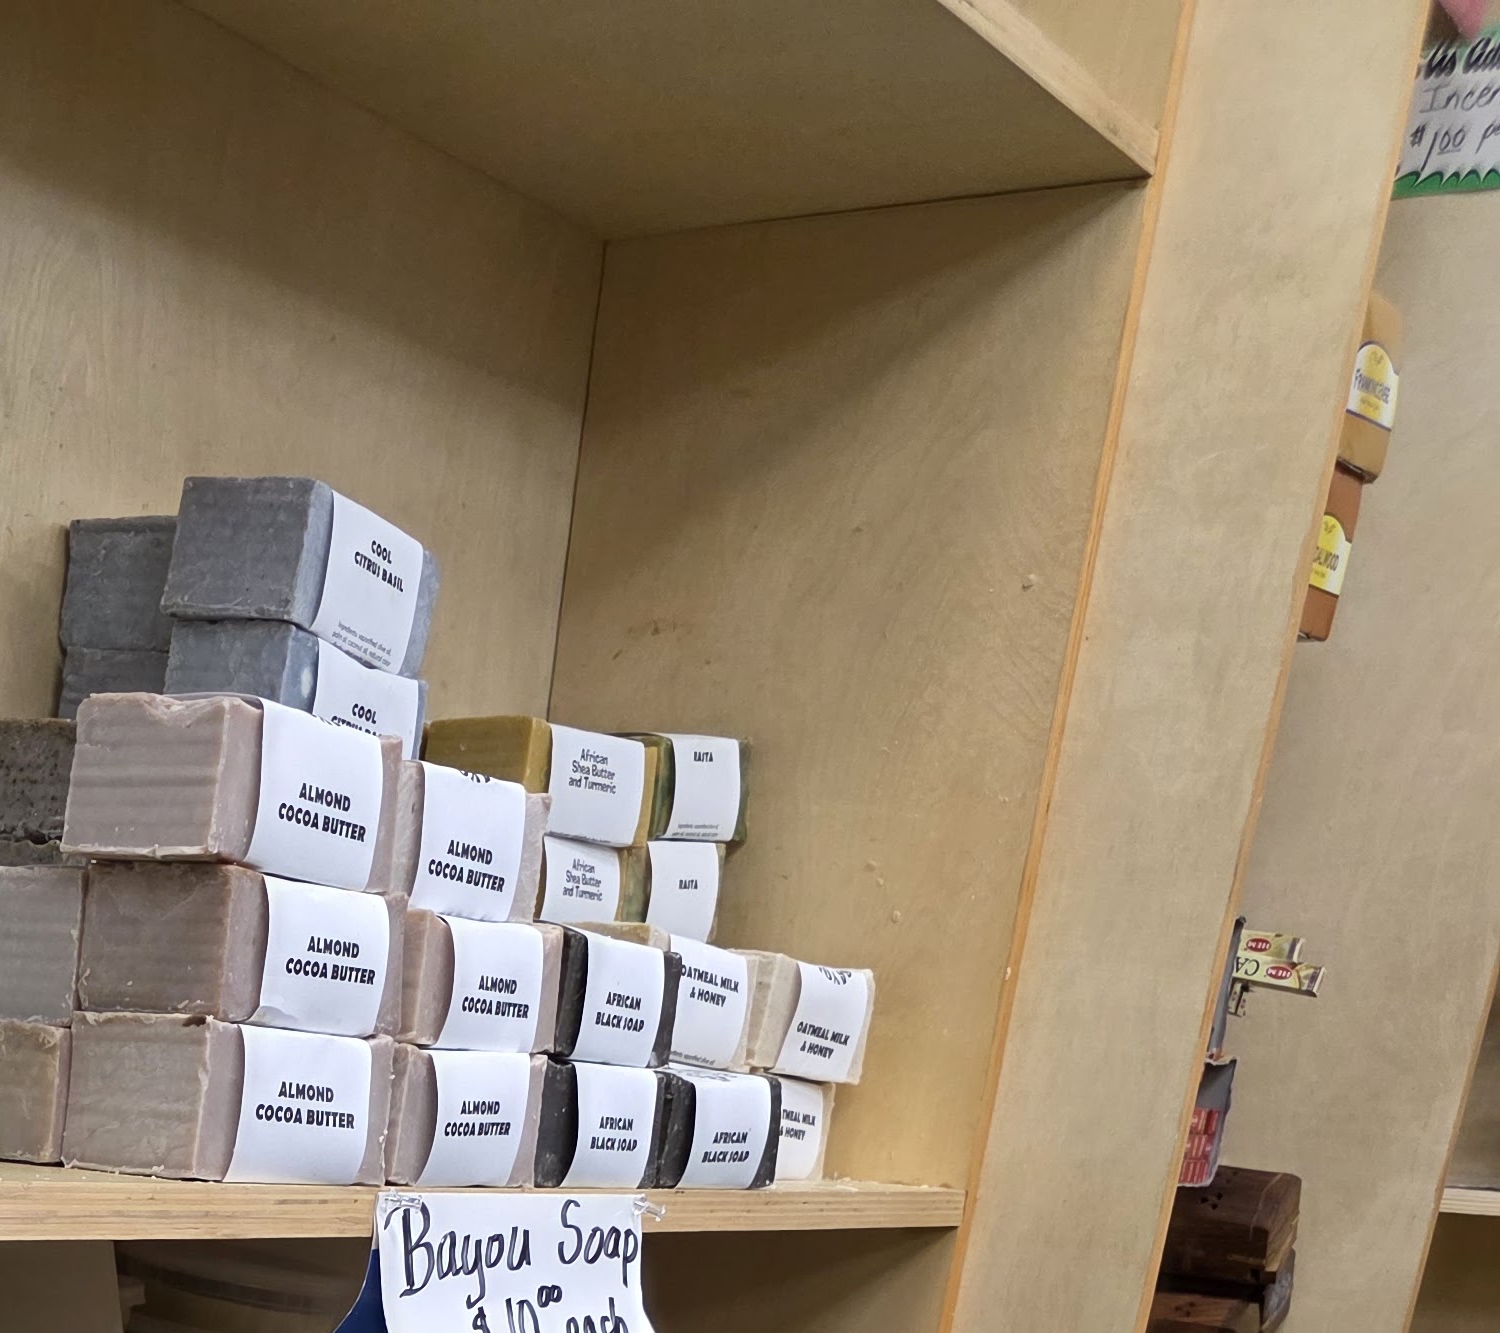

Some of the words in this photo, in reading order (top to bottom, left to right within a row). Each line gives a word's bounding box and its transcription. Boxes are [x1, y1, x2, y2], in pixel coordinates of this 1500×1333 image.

[371, 540, 393, 565] COOL
[354, 551, 381, 579] CITRUS
[381, 568, 404, 593] BASIL
[351, 703, 377, 725] COOL
[580, 748, 609, 766] African
[572, 760, 591, 777] Shea
[591, 764, 616, 781] Butter
[299, 783, 351, 813] ALMOND
[278, 803, 320, 834] COCOA
[322, 814, 366, 843] BUTTER
[447, 839, 493, 866] ALMOND
[428, 858, 464, 884] COCOA
[466, 866, 505, 893] BUTTER
[307, 935, 360, 959] ALMOND
[285, 957, 328, 979] COCOA
[330, 963, 376, 986] BUTTER
[680, 964, 719, 986] OATMEAL
[720, 976, 740, 993] MILK
[478, 975, 517, 995] ALMOND
[462, 996, 493, 1016] COCOA
[494, 1000, 530, 1019] BUTTER
[605, 991, 642, 1011] AFRICAN
[697, 989, 726, 1009] HONEY
[595, 1011, 622, 1030] BLACK
[623, 1014, 645, 1033] SOAP
[796, 1020, 830, 1039] OATMEAL
[830, 1029, 850, 1046] MILK
[808, 1042, 835, 1059] HONEY
[277, 1081, 334, 1103] ALMOND
[255, 1103, 303, 1125] COCOA
[305, 1108, 355, 1130] BUTTER
[460, 1100, 501, 1115] ALMOND
[444, 1121, 476, 1137] COCOA
[477, 1122, 510, 1137] BUTTER
[599, 1116, 634, 1132] AFRICAN
[802, 1114, 816, 1128] MILK
[590, 1136, 617, 1152] BLACK
[618, 1137, 638, 1152] SOAP
[712, 1131, 748, 1144] AFRICAN
[785, 1127, 806, 1141] HONEY
[701, 1151, 728, 1164] BLACK
[729, 1150, 750, 1163] SOAP
[384, 1202, 531, 1309] Bayou
[558, 1199, 639, 1288] Soap
